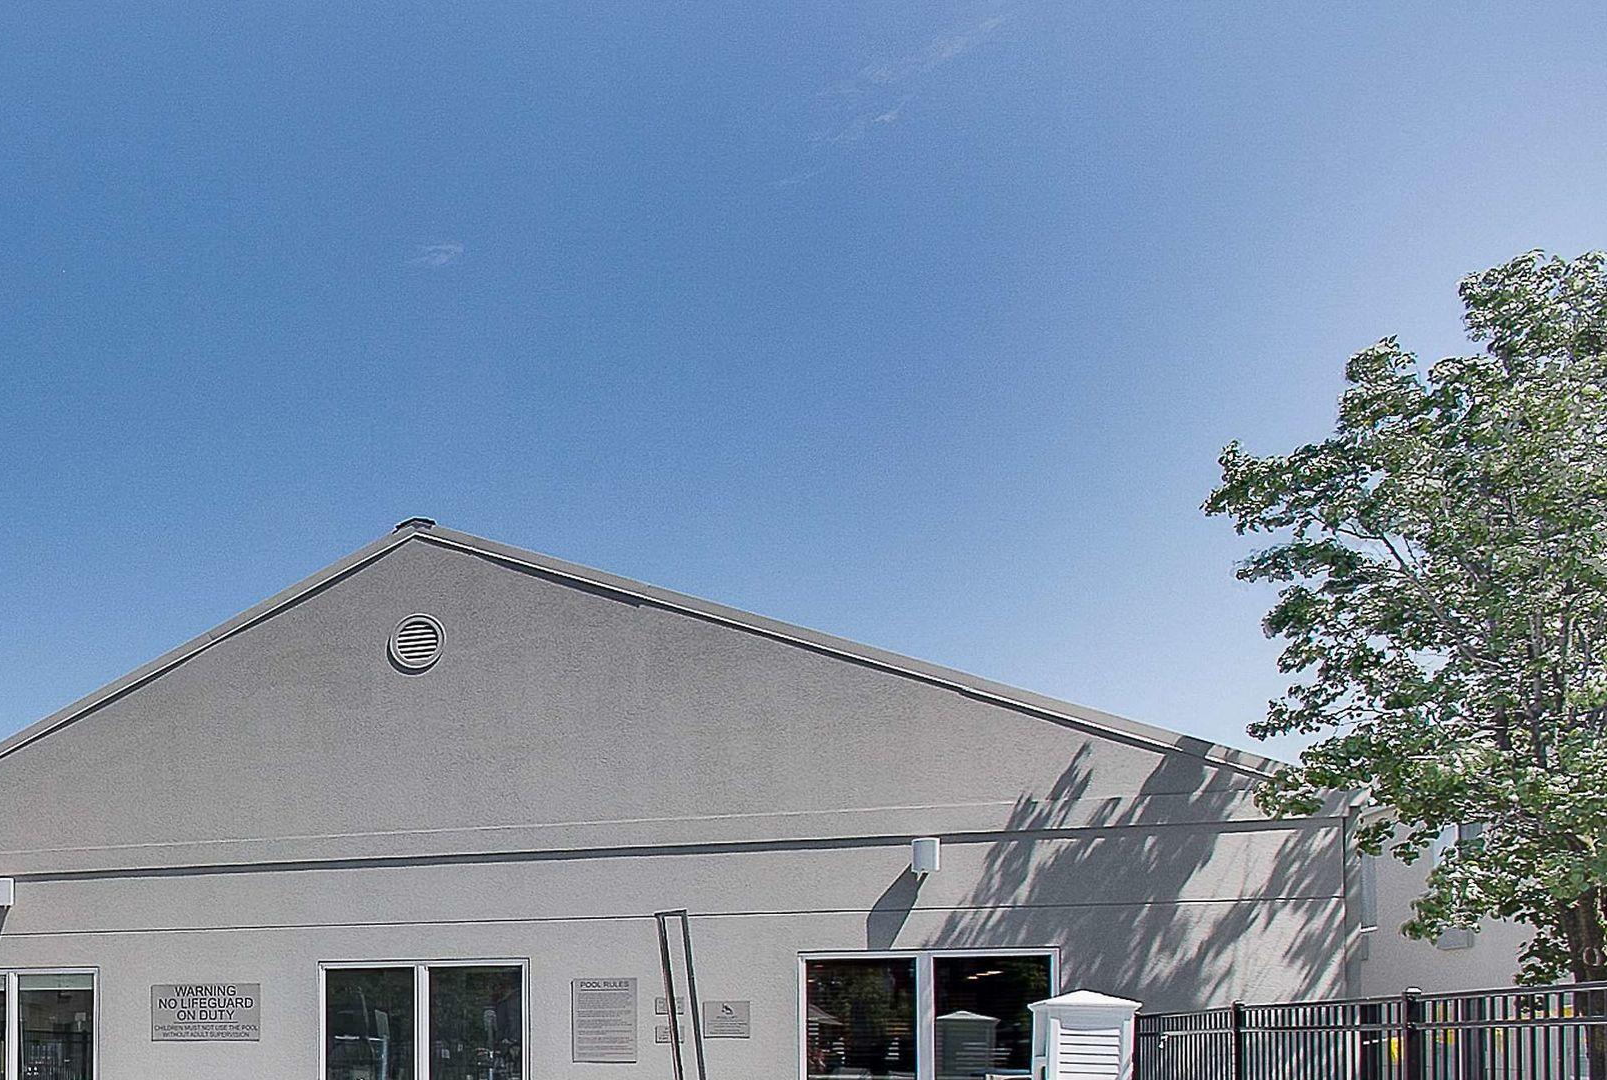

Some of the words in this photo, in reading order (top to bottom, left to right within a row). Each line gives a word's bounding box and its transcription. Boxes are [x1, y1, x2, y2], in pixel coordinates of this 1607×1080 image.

[174, 985, 237, 997] WARNING
[158, 998, 177, 1009] NO
[180, 997, 254, 1009] LIFEGUARD
[176, 1009, 196, 1021] ON
[199, 1009, 234, 1020] DUTY
